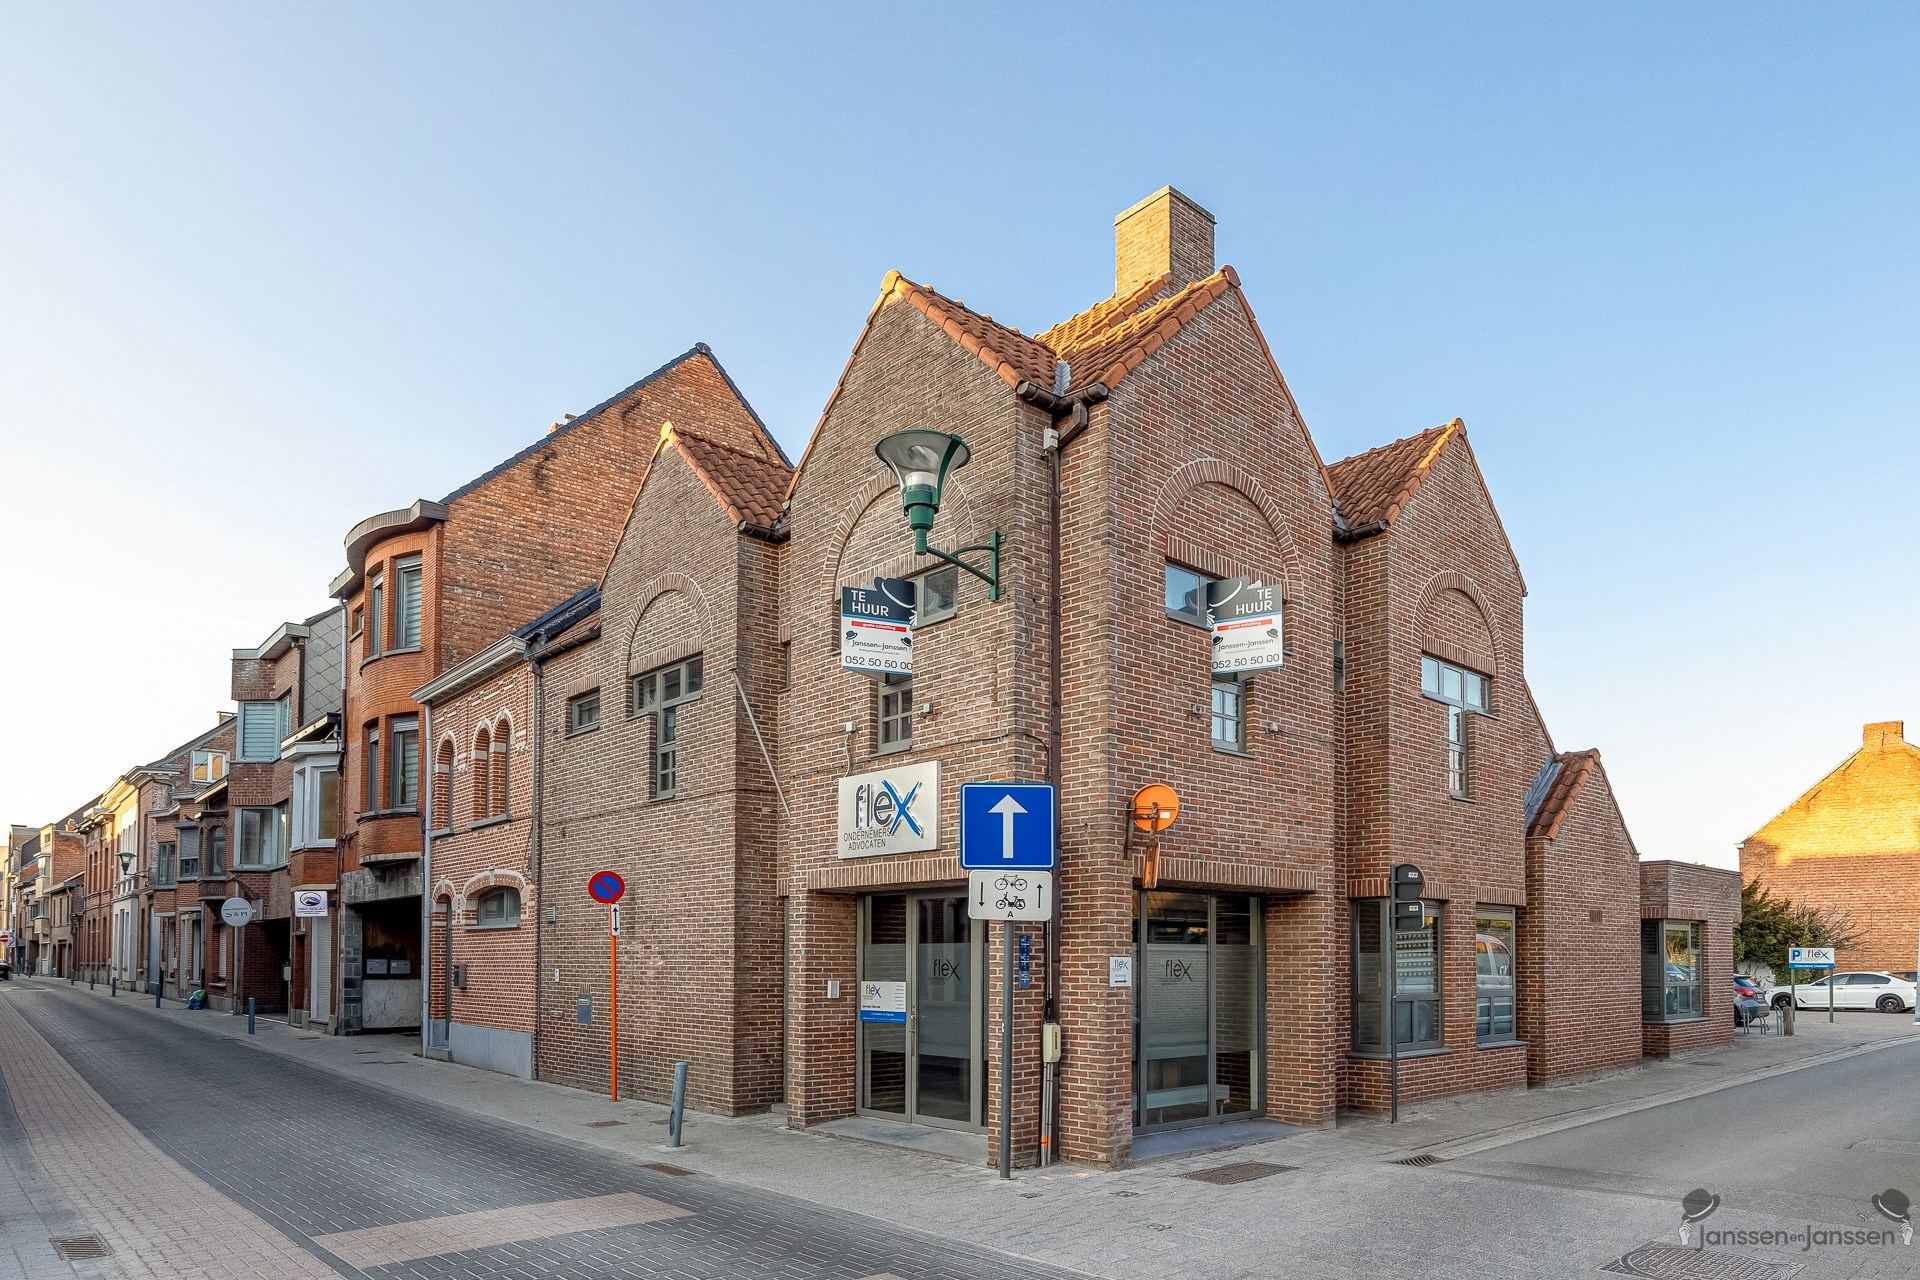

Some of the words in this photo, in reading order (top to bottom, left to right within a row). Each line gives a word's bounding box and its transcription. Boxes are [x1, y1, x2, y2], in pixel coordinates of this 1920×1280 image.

[851, 590, 866, 602] TE
[1257, 588, 1272, 600] TE
[852, 602, 889, 617] HUUR
[1235, 600, 1273, 615] HUUR
[845, 655, 865, 666] 052
[868, 657, 881, 667] 50
[884, 659, 898, 669] 50
[900, 661, 913, 670] 00
[1212, 659, 1231, 670] 052
[1234, 657, 1247, 667] 50
[1250, 655, 1264, 665] 50
[1266, 653, 1280, 663] 00
[844, 827, 890, 842] ONDERNEMERS
[848, 839, 886, 851] ADVOCATEN
